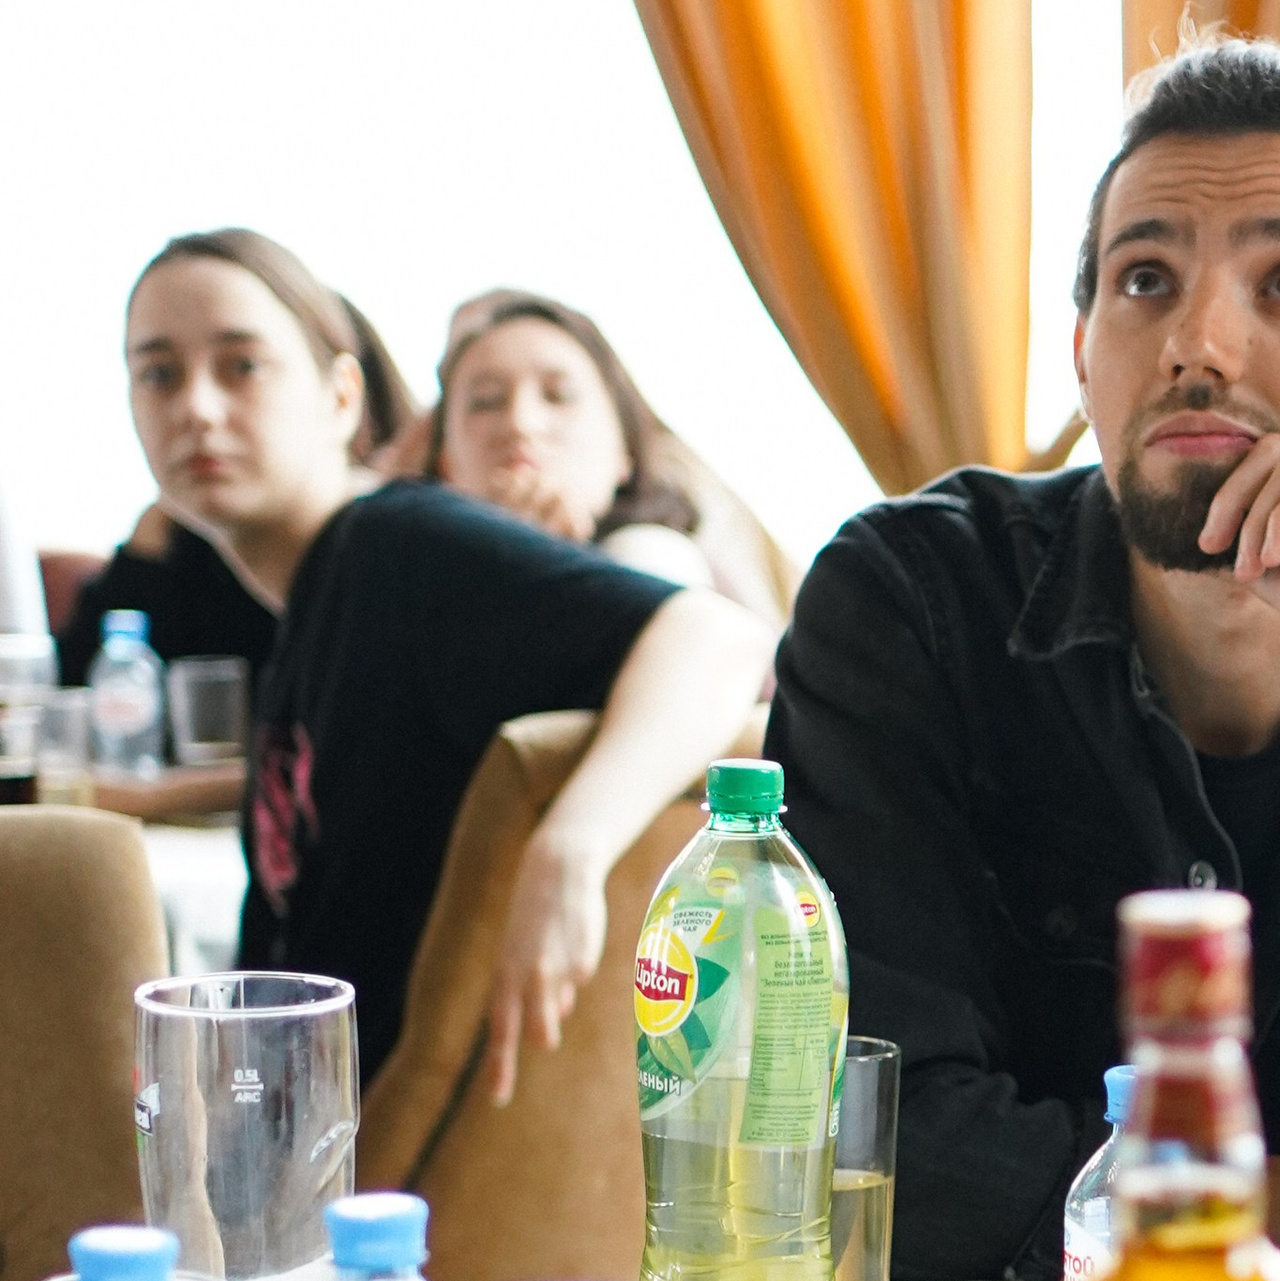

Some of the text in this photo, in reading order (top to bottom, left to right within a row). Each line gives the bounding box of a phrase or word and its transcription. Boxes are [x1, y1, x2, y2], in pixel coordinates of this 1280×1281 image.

[673, 910, 713, 920] СВЕЖЕСТЬ
[636, 962, 681, 995] Lipton
[638, 1069, 682, 1096] ЛЕНЫЙ
[233, 1091, 262, 1103] ARC
